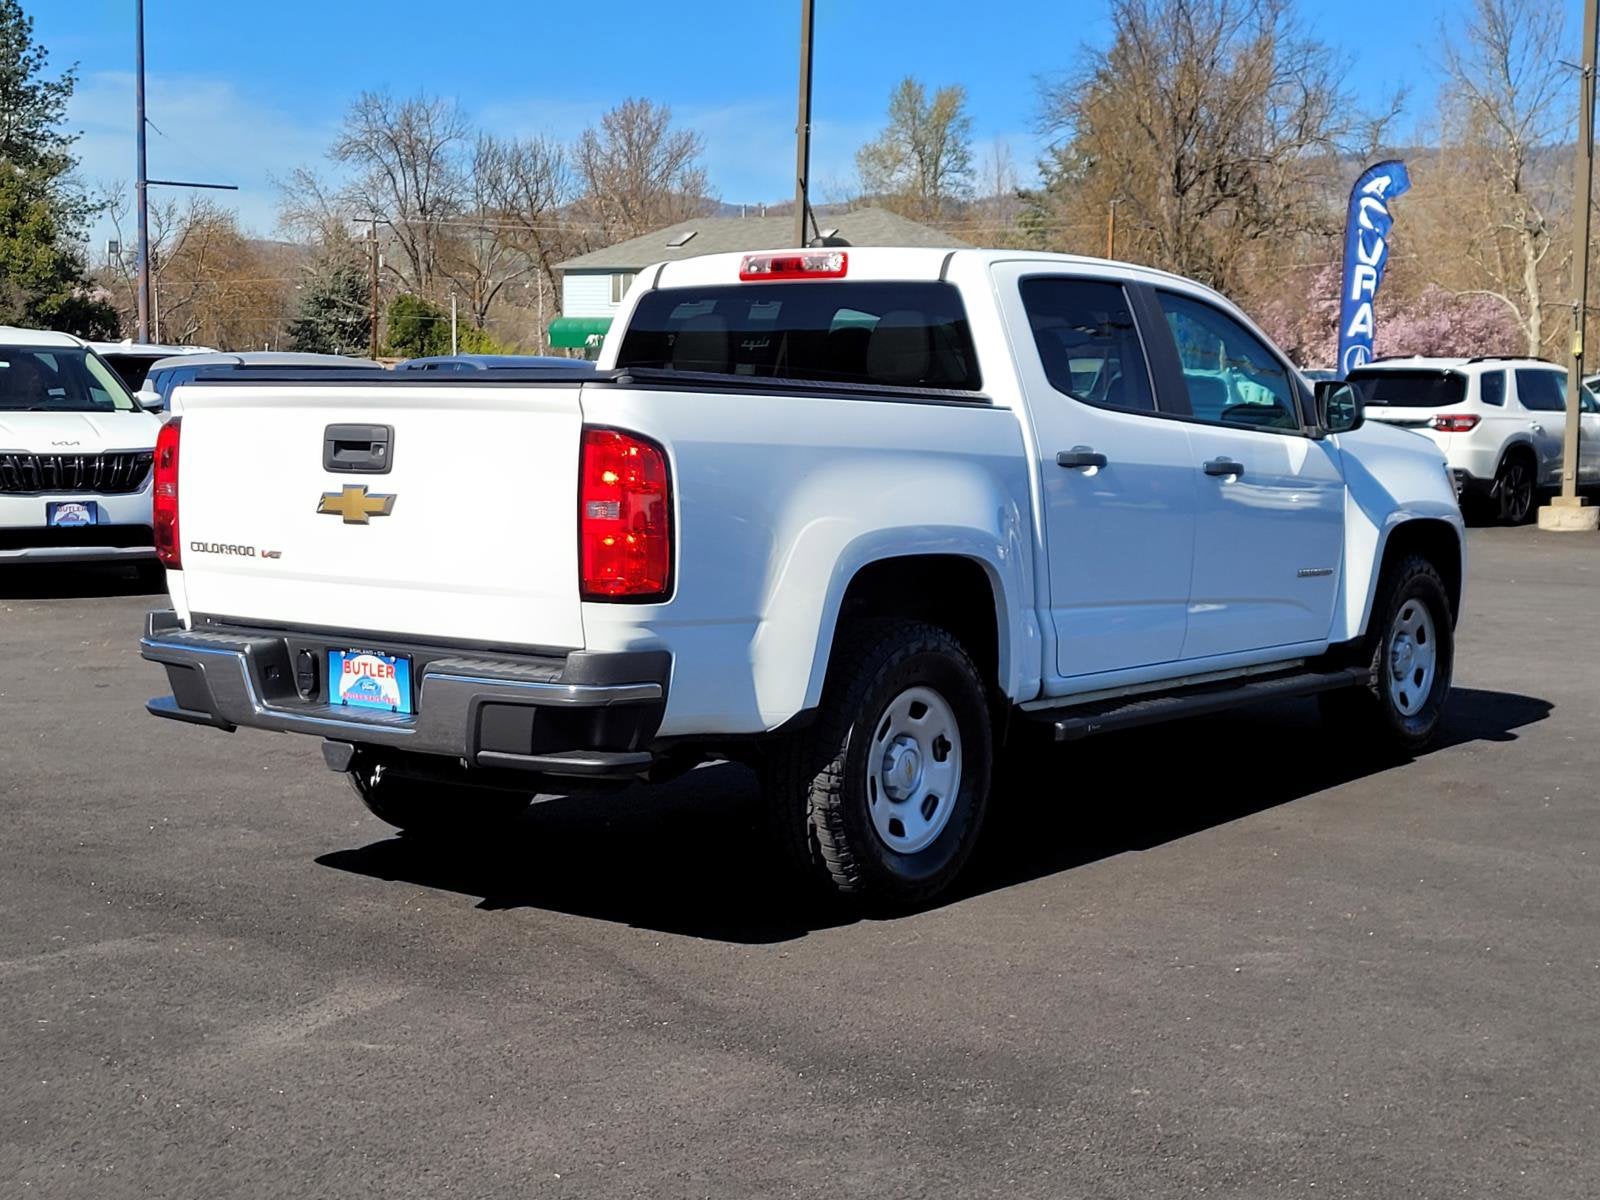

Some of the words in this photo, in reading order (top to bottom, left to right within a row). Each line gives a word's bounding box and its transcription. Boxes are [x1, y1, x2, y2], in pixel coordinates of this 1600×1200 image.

[1347, 175, 1392, 339] ACURA
[190, 541, 256, 557] COLORADO
[343, 660, 395, 679] BUTLER
